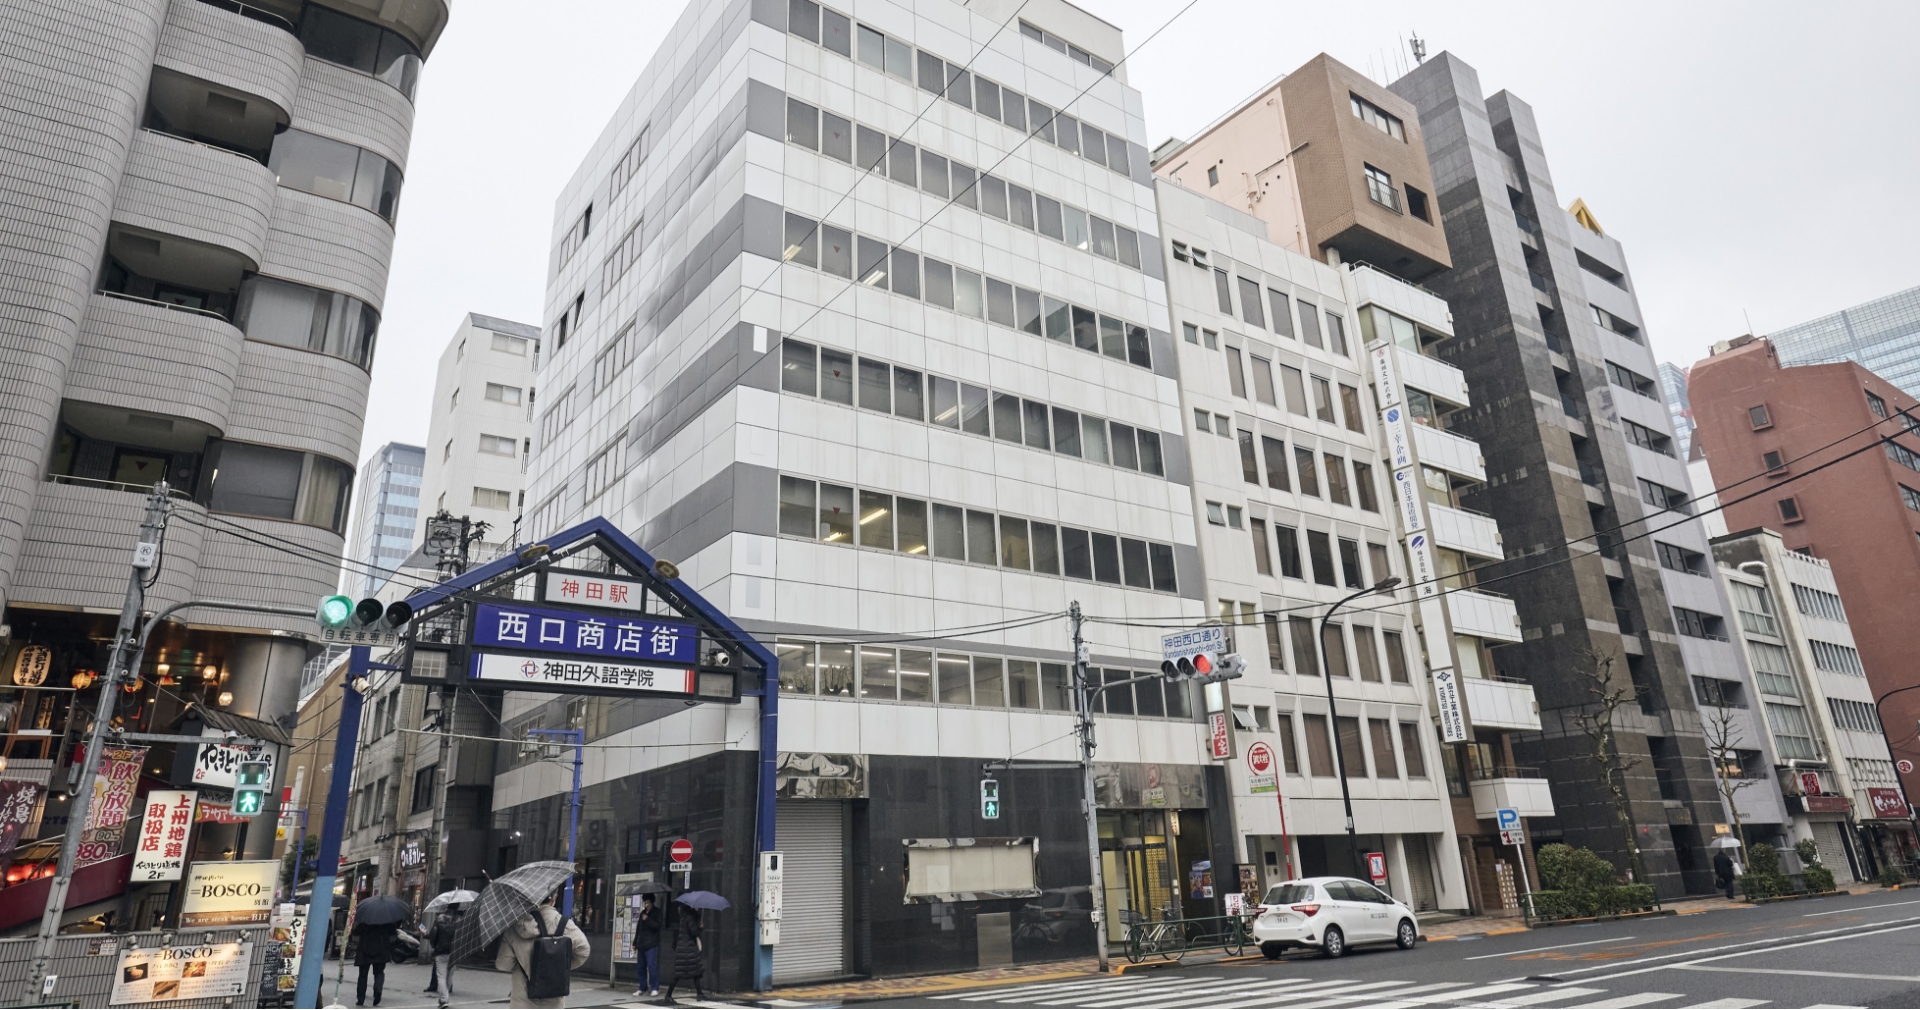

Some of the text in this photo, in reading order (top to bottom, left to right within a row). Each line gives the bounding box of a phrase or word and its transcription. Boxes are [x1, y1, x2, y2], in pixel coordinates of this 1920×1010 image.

[560, 578, 628, 603] 神田駅
[325, 628, 395, 644] 自転車専用
[498, 611, 679, 656] 西口商店街
[1164, 628, 1221, 649] 神田西口通り
[543, 661, 655, 687] 神田外語学院
[111, 750, 134, 760] 2F
[195, 768, 206, 780] 2F
[16, 785, 36, 823] 焼鳥
[100, 761, 139, 827] 飲み放題
[141, 803, 167, 852] 取扱店
[163, 794, 191, 857] 上州地鶏
[1498, 809, 1517, 829] P
[148, 871, 165, 879] 2F
[201, 883, 261, 898] BOSCO
[251, 912, 270, 921] B1F
[163, 947, 212, 960] BOSCO
